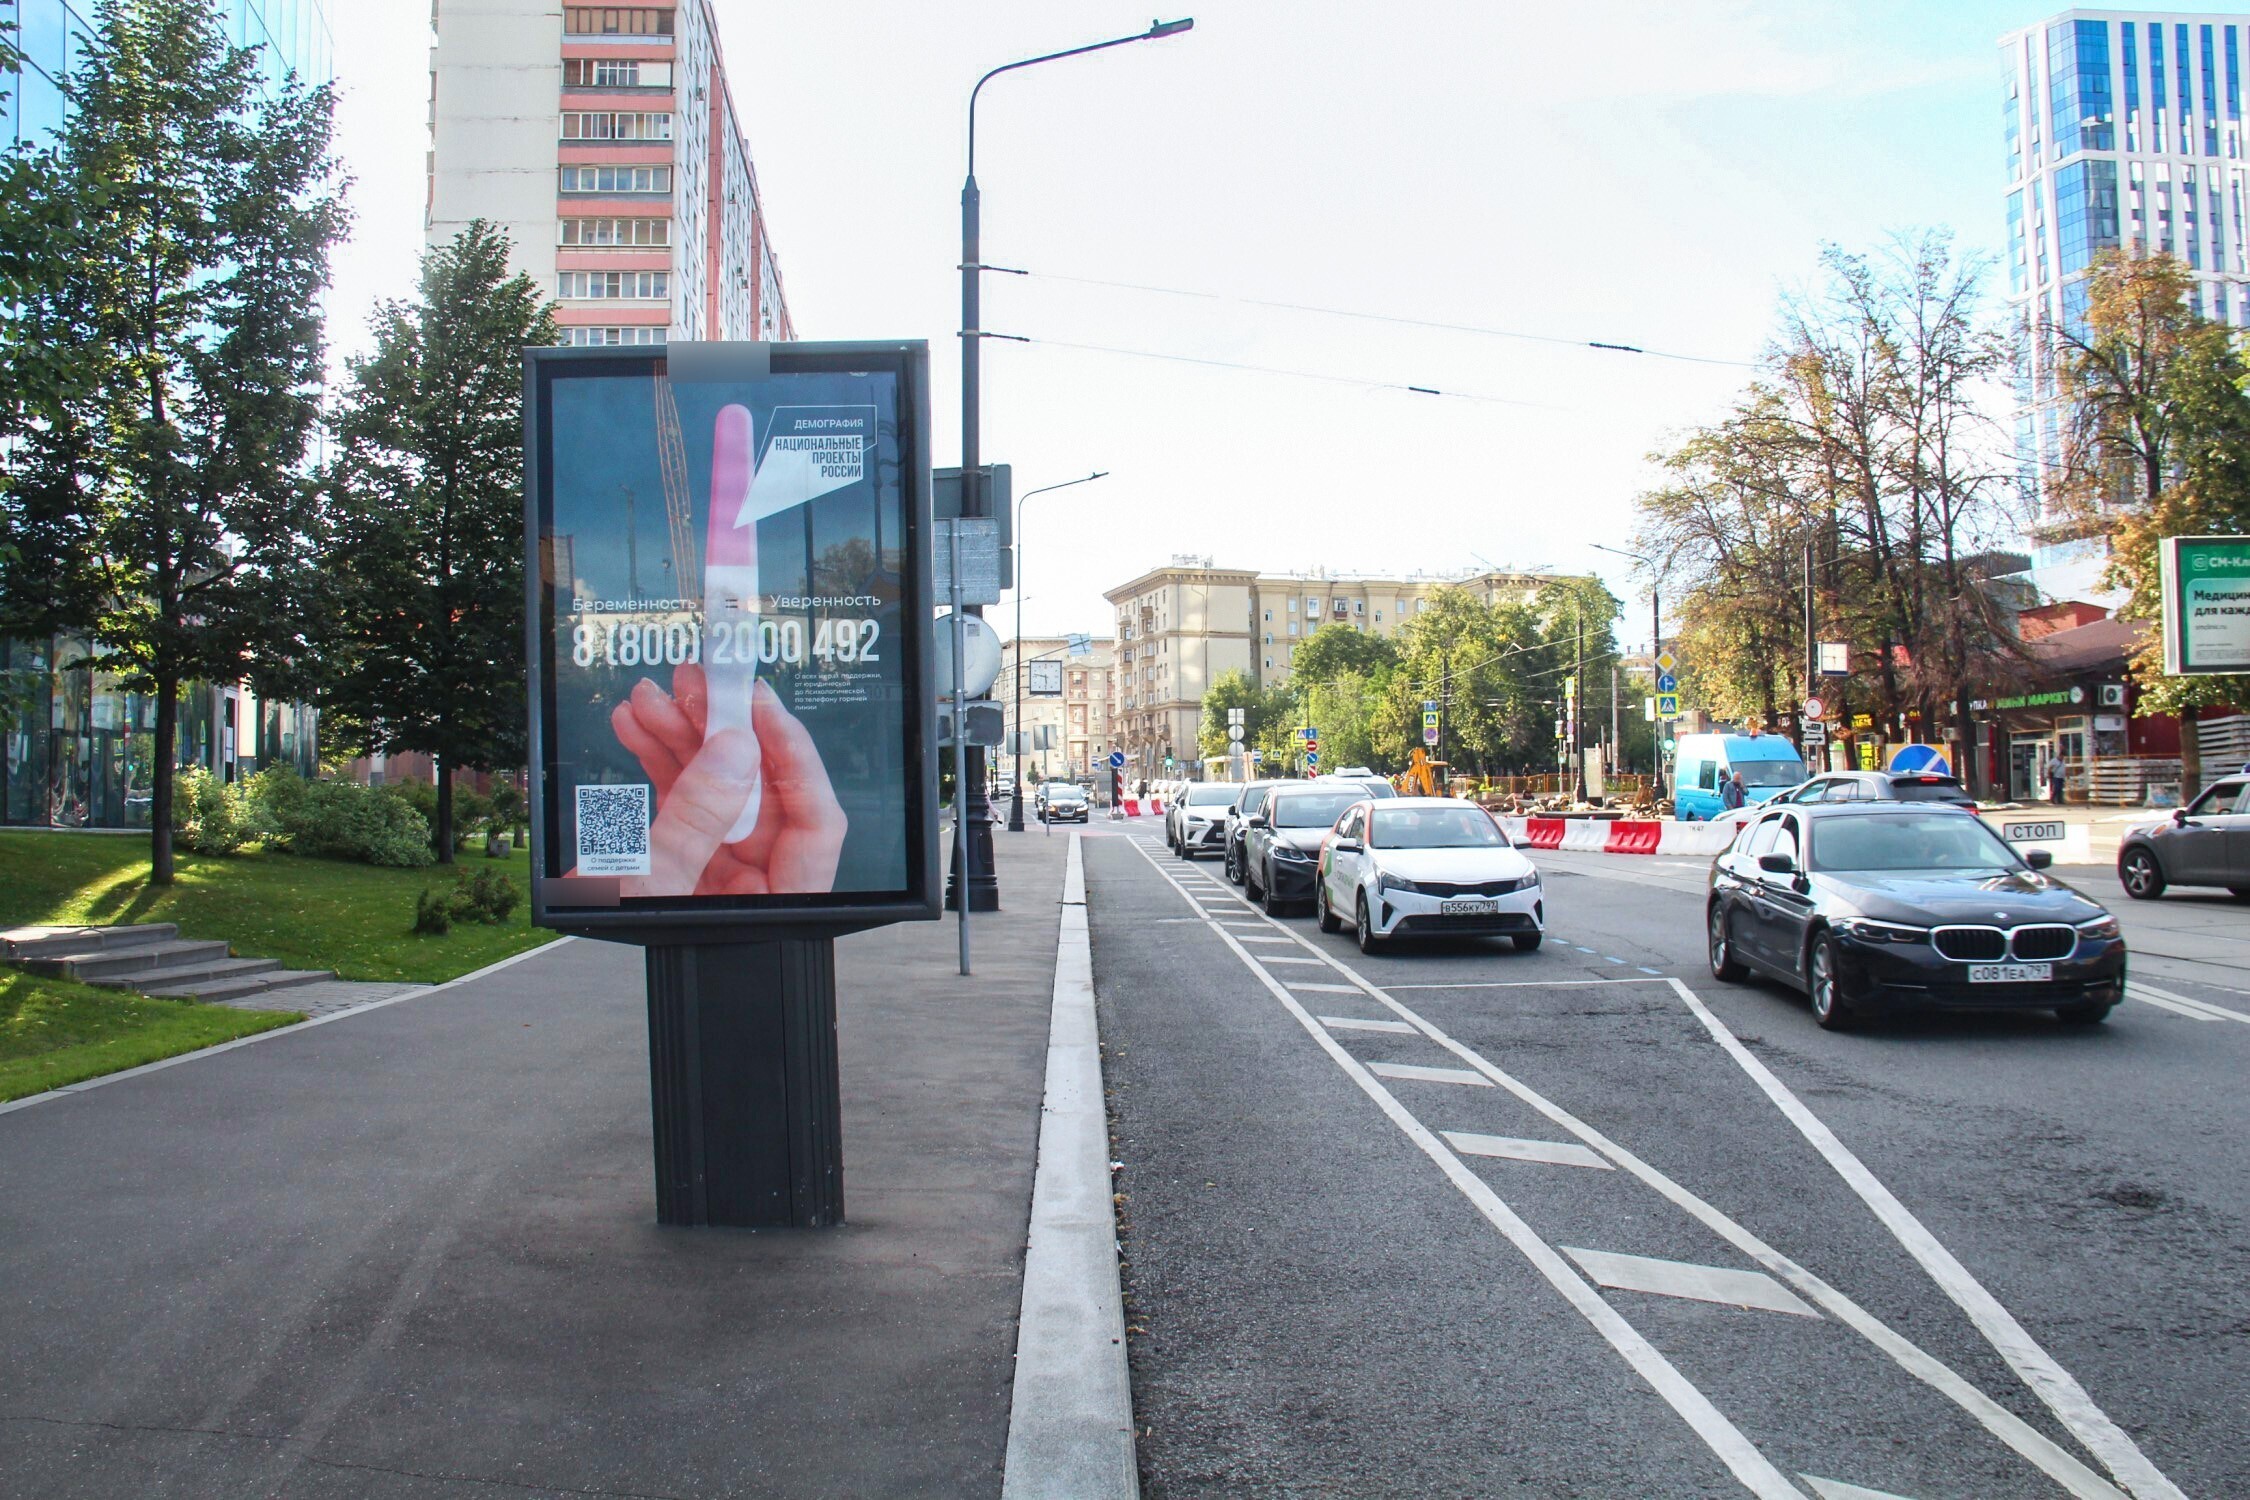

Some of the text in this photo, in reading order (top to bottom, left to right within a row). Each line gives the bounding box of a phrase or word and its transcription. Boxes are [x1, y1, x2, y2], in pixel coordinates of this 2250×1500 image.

[794, 418, 864, 430] ДЕМОГРАФИЯ
[775, 437, 862, 452] НАЦИОНАЛЬНЫЕ
[812, 451, 862, 464] ПРОЕКТЫ
[821, 465, 862, 478] РОССИИ
[573, 597, 697, 613] Беременность
[770, 594, 882, 610] Уверенность
[2194, 607, 2218, 617] для
[573, 618, 880, 667] 8 (800) 2000 492
[2028, 690, 2070, 706] МАРКЕТ
[2013, 824, 2056, 838] СТОП
